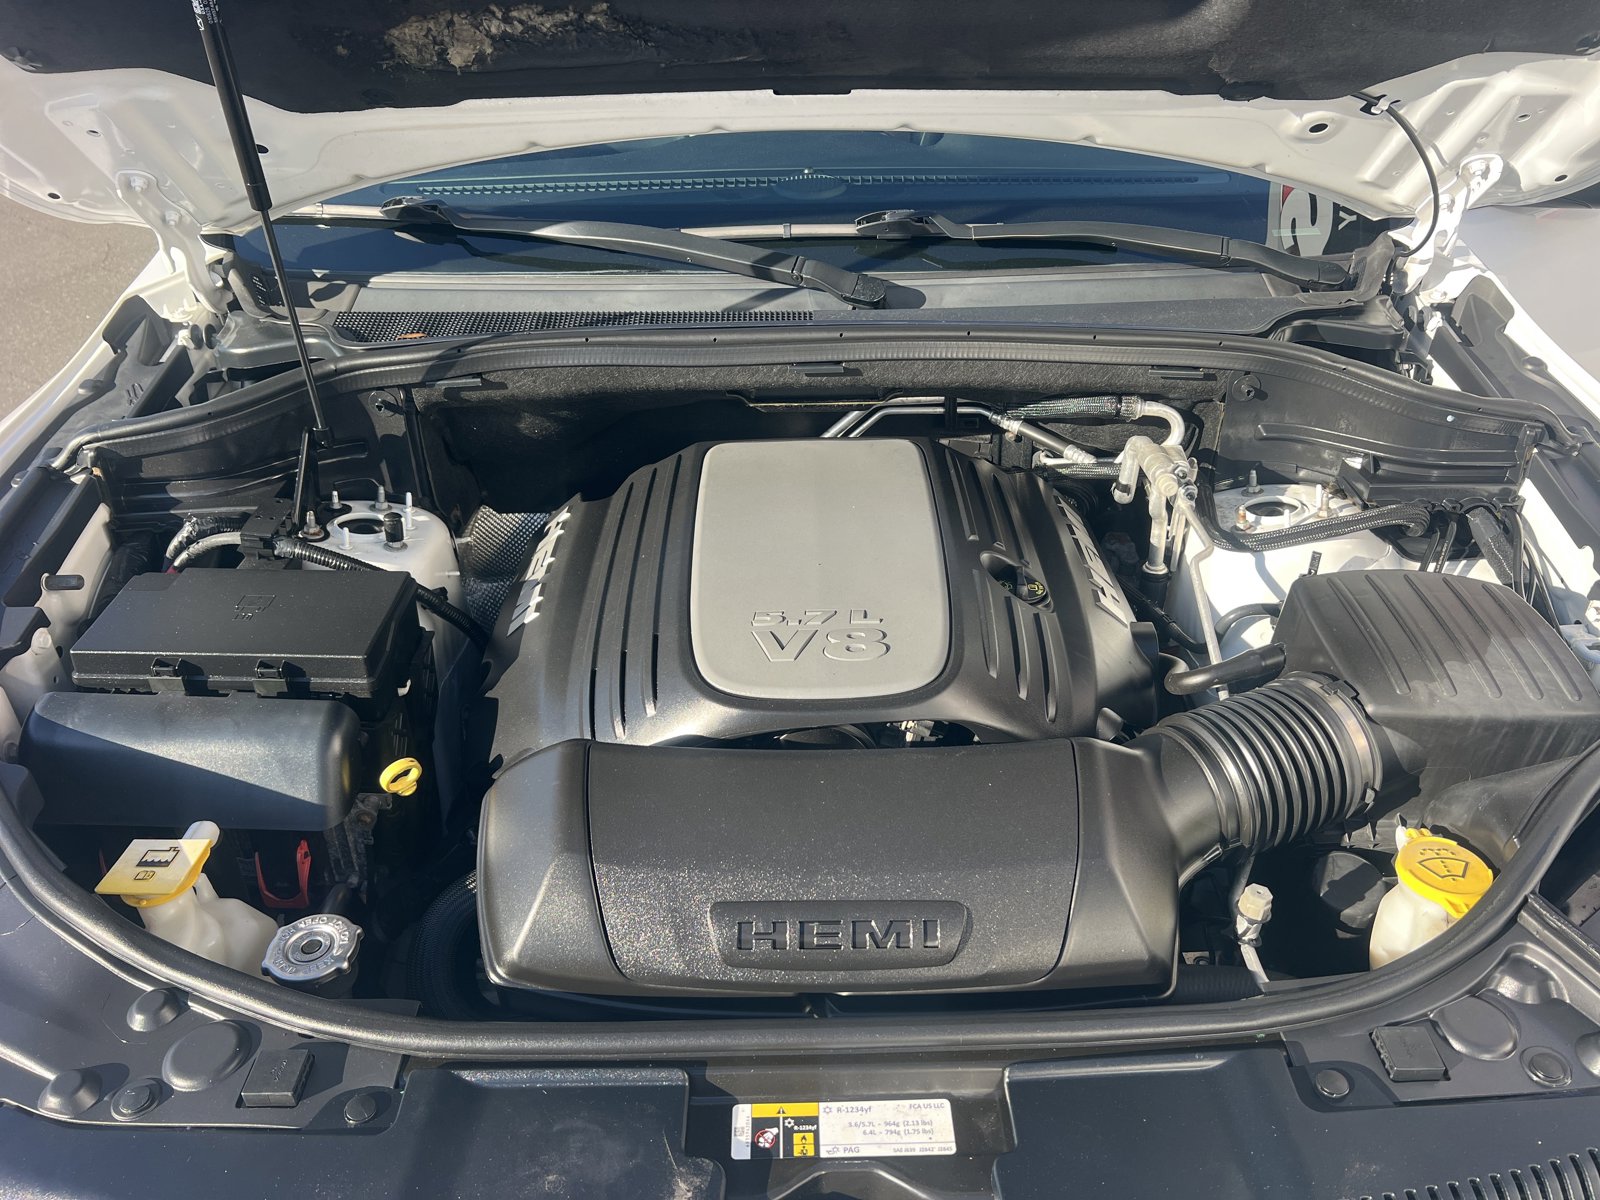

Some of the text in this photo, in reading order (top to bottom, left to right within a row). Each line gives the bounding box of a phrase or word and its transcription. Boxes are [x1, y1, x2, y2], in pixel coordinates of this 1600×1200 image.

[751, 627, 891, 662] V8
[297, 916, 328, 929] OPEN
[737, 919, 940, 950] HEMI
[836, 1106, 872, 1114] R-1234yf
[920, 1119, 933, 1127] lbs)
[884, 1129, 900, 1137] 794g
[921, 1128, 934, 1136] lbs)
